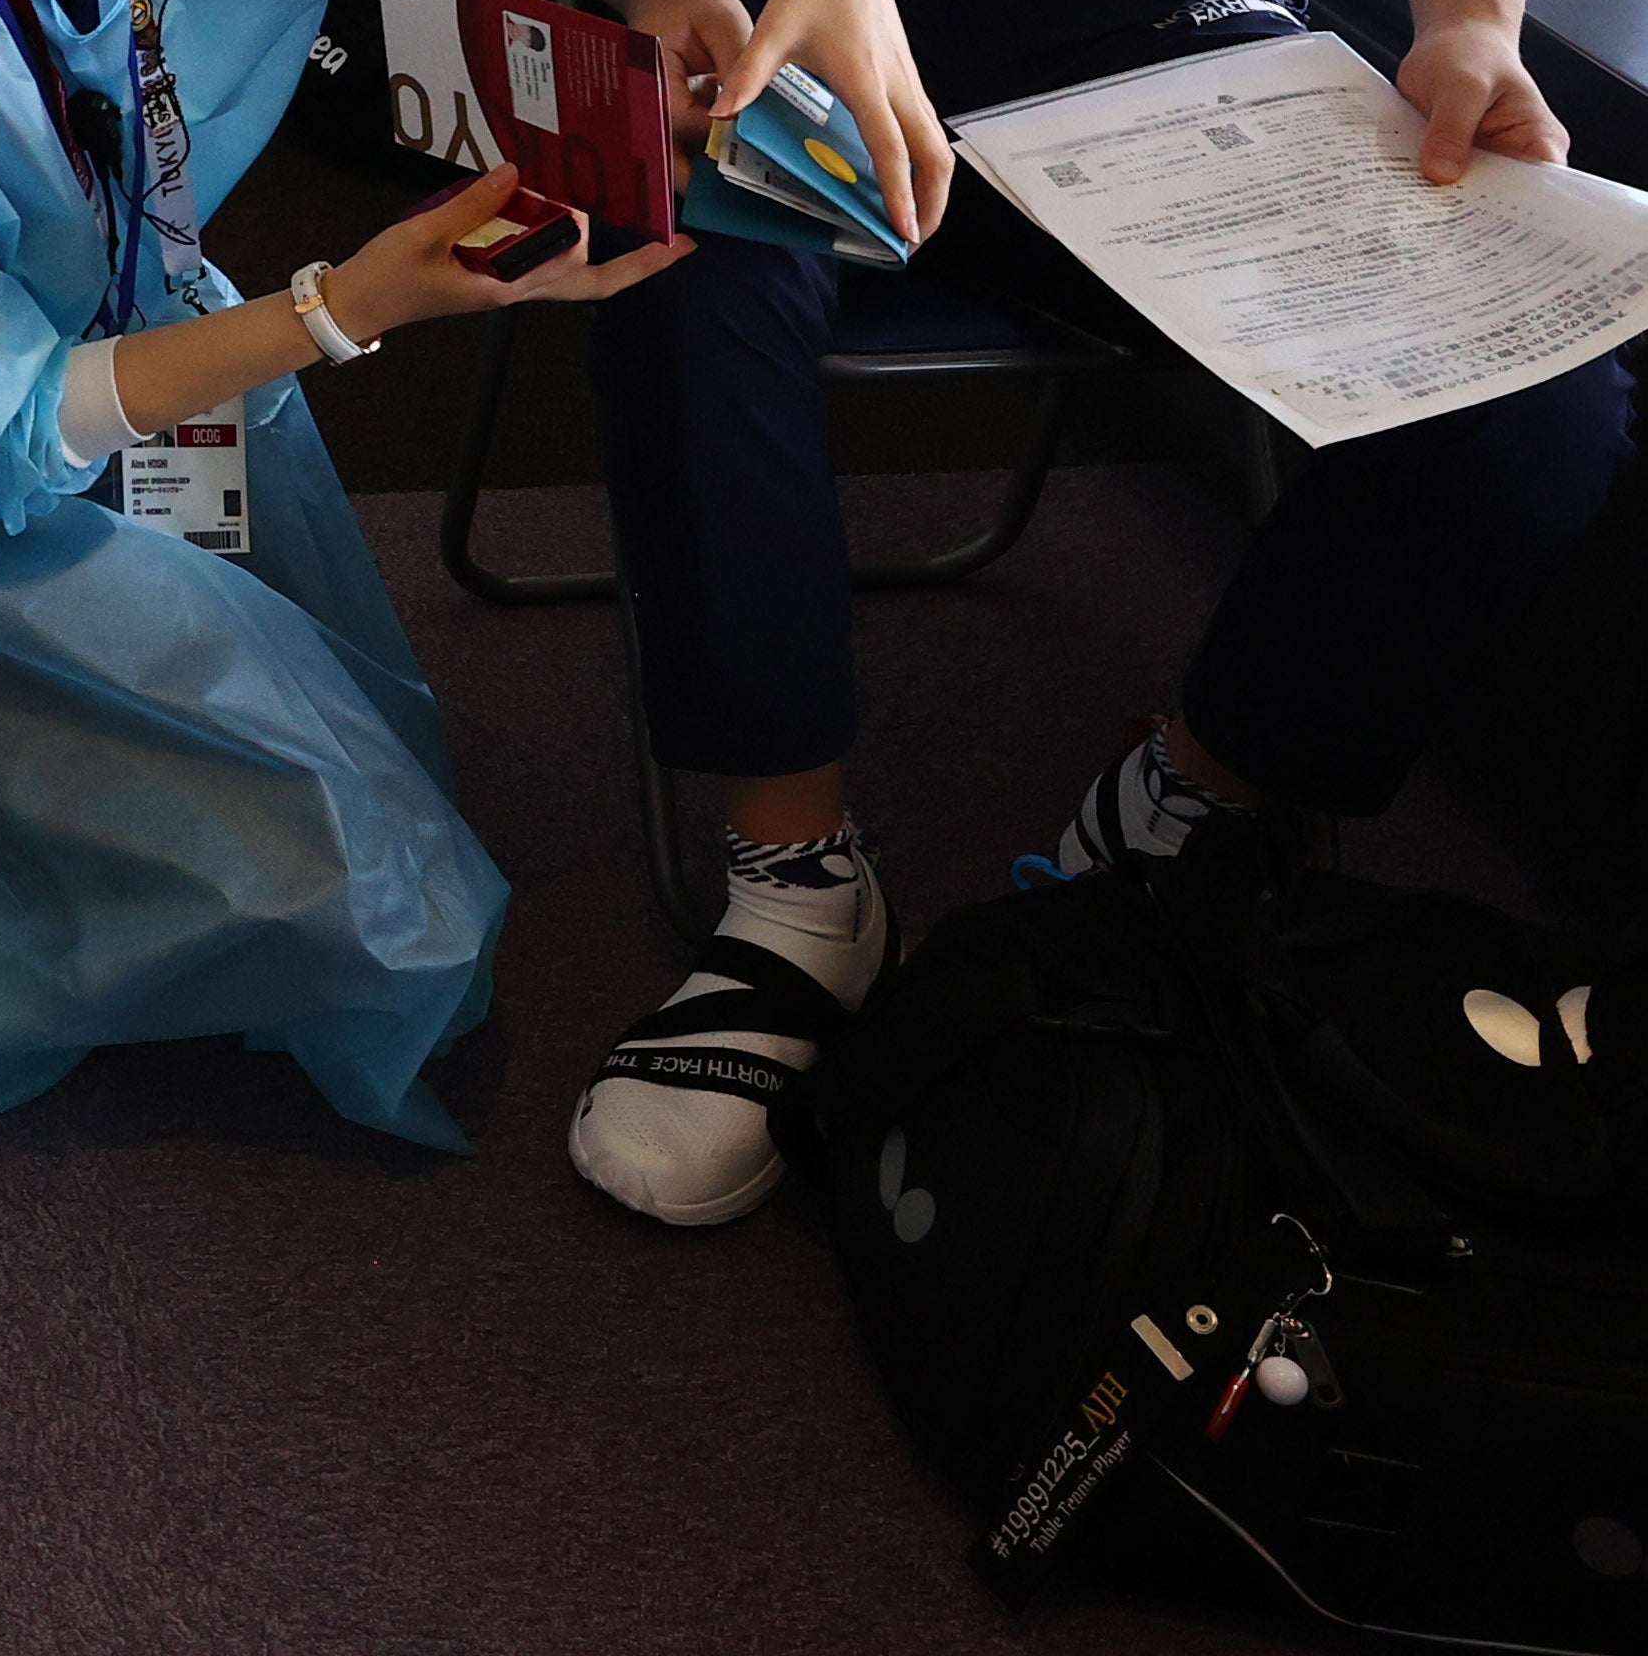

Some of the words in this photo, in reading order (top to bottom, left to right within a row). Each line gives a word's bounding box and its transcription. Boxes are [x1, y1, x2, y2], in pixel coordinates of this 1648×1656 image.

[192, 428, 221, 444] OCOG
[649, 1055, 703, 1075] FACE
[707, 1058, 785, 1092] NORTH
[1027, 1515, 1066, 1556] Table
[1055, 1470, 1098, 1519] Tennis
[1091, 1429, 1135, 1479] Player
